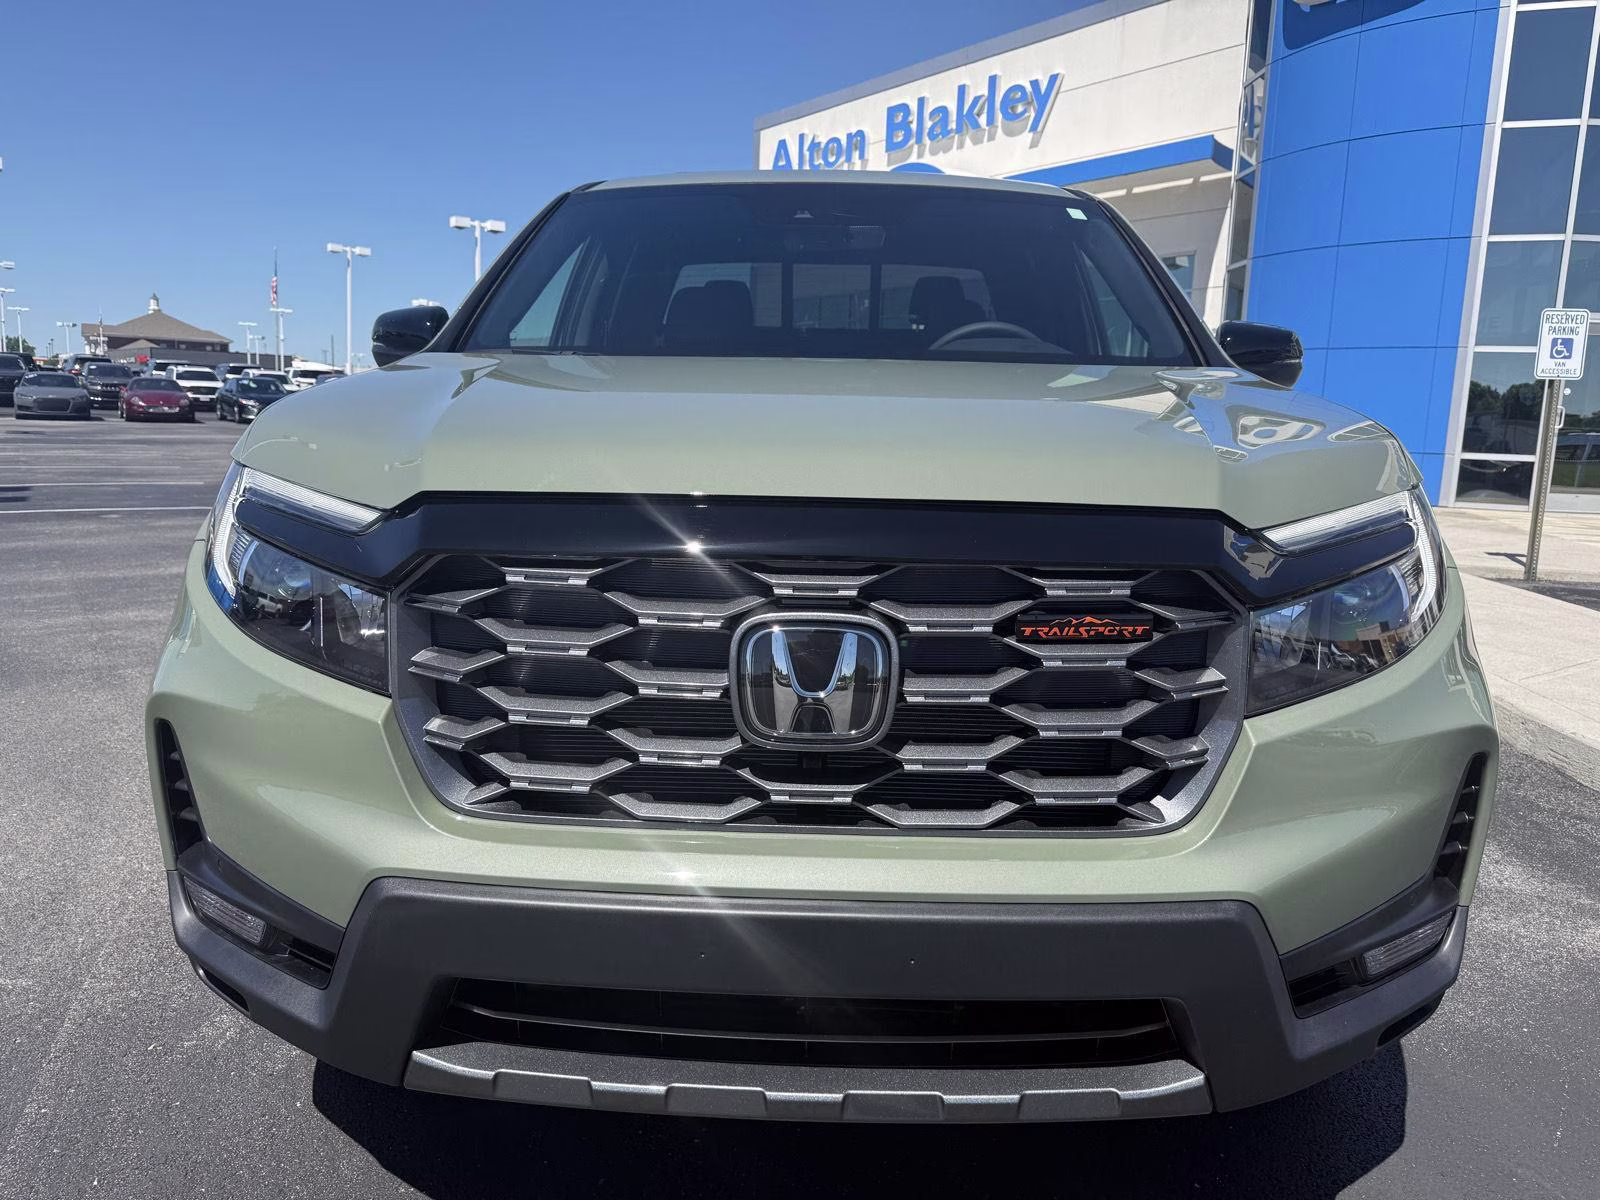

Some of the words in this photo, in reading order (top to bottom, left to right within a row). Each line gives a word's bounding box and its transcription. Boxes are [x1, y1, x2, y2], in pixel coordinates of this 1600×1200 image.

[772, 129, 866, 170] Alton
[885, 73, 1060, 153] Blakley
[1545, 314, 1585, 325] RESERVED
[1548, 325, 1580, 336] PARKING
[1020, 626, 1150, 638] TRAILSPORT
